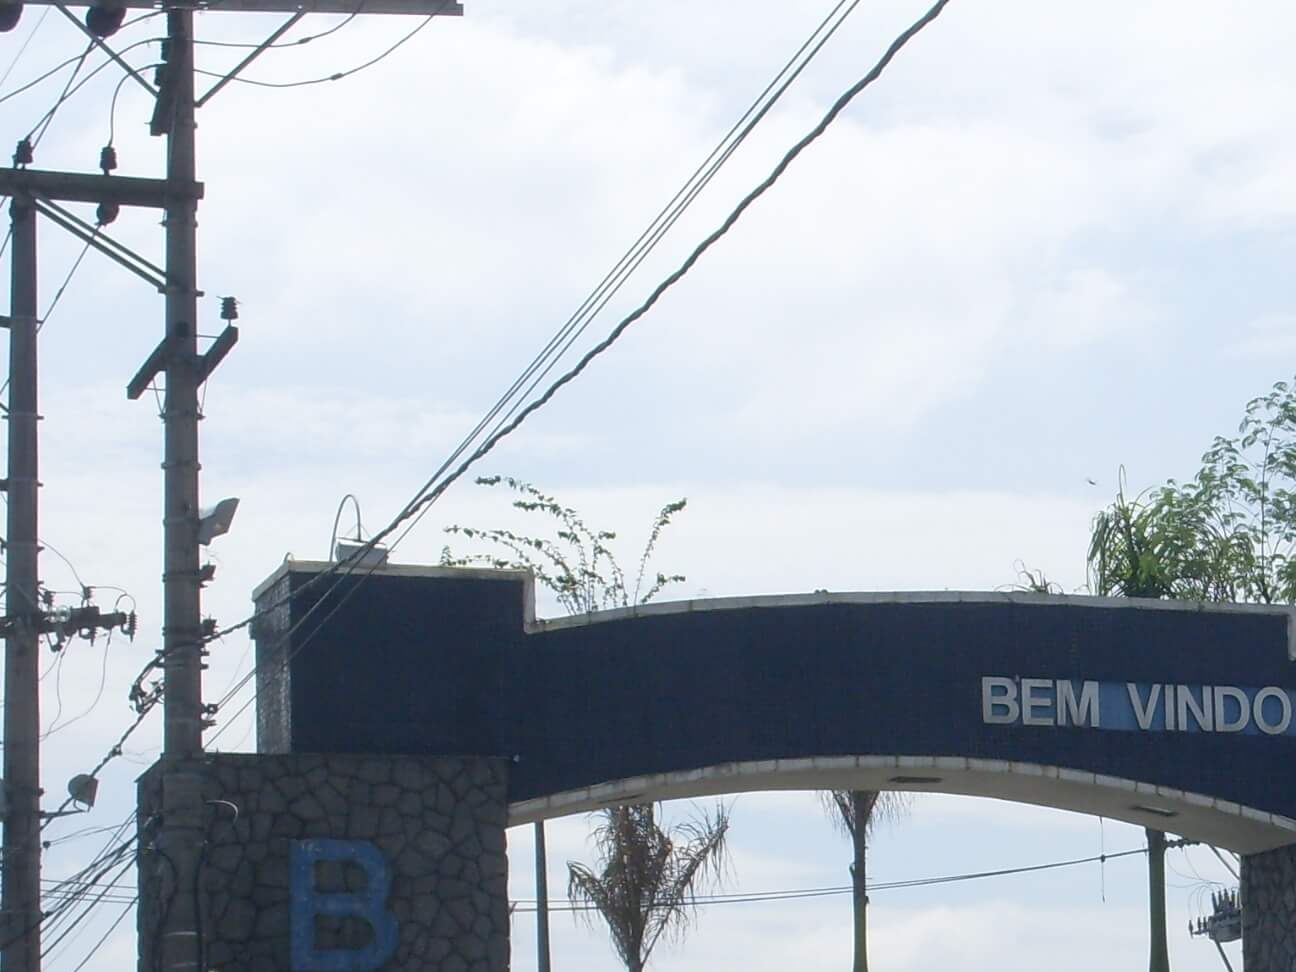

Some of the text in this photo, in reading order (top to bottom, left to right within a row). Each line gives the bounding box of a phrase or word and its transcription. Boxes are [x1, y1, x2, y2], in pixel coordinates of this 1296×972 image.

[982, 676, 1100, 727] BEM
[1127, 682, 1292, 734] VINDO
[290, 838, 399, 972] B
